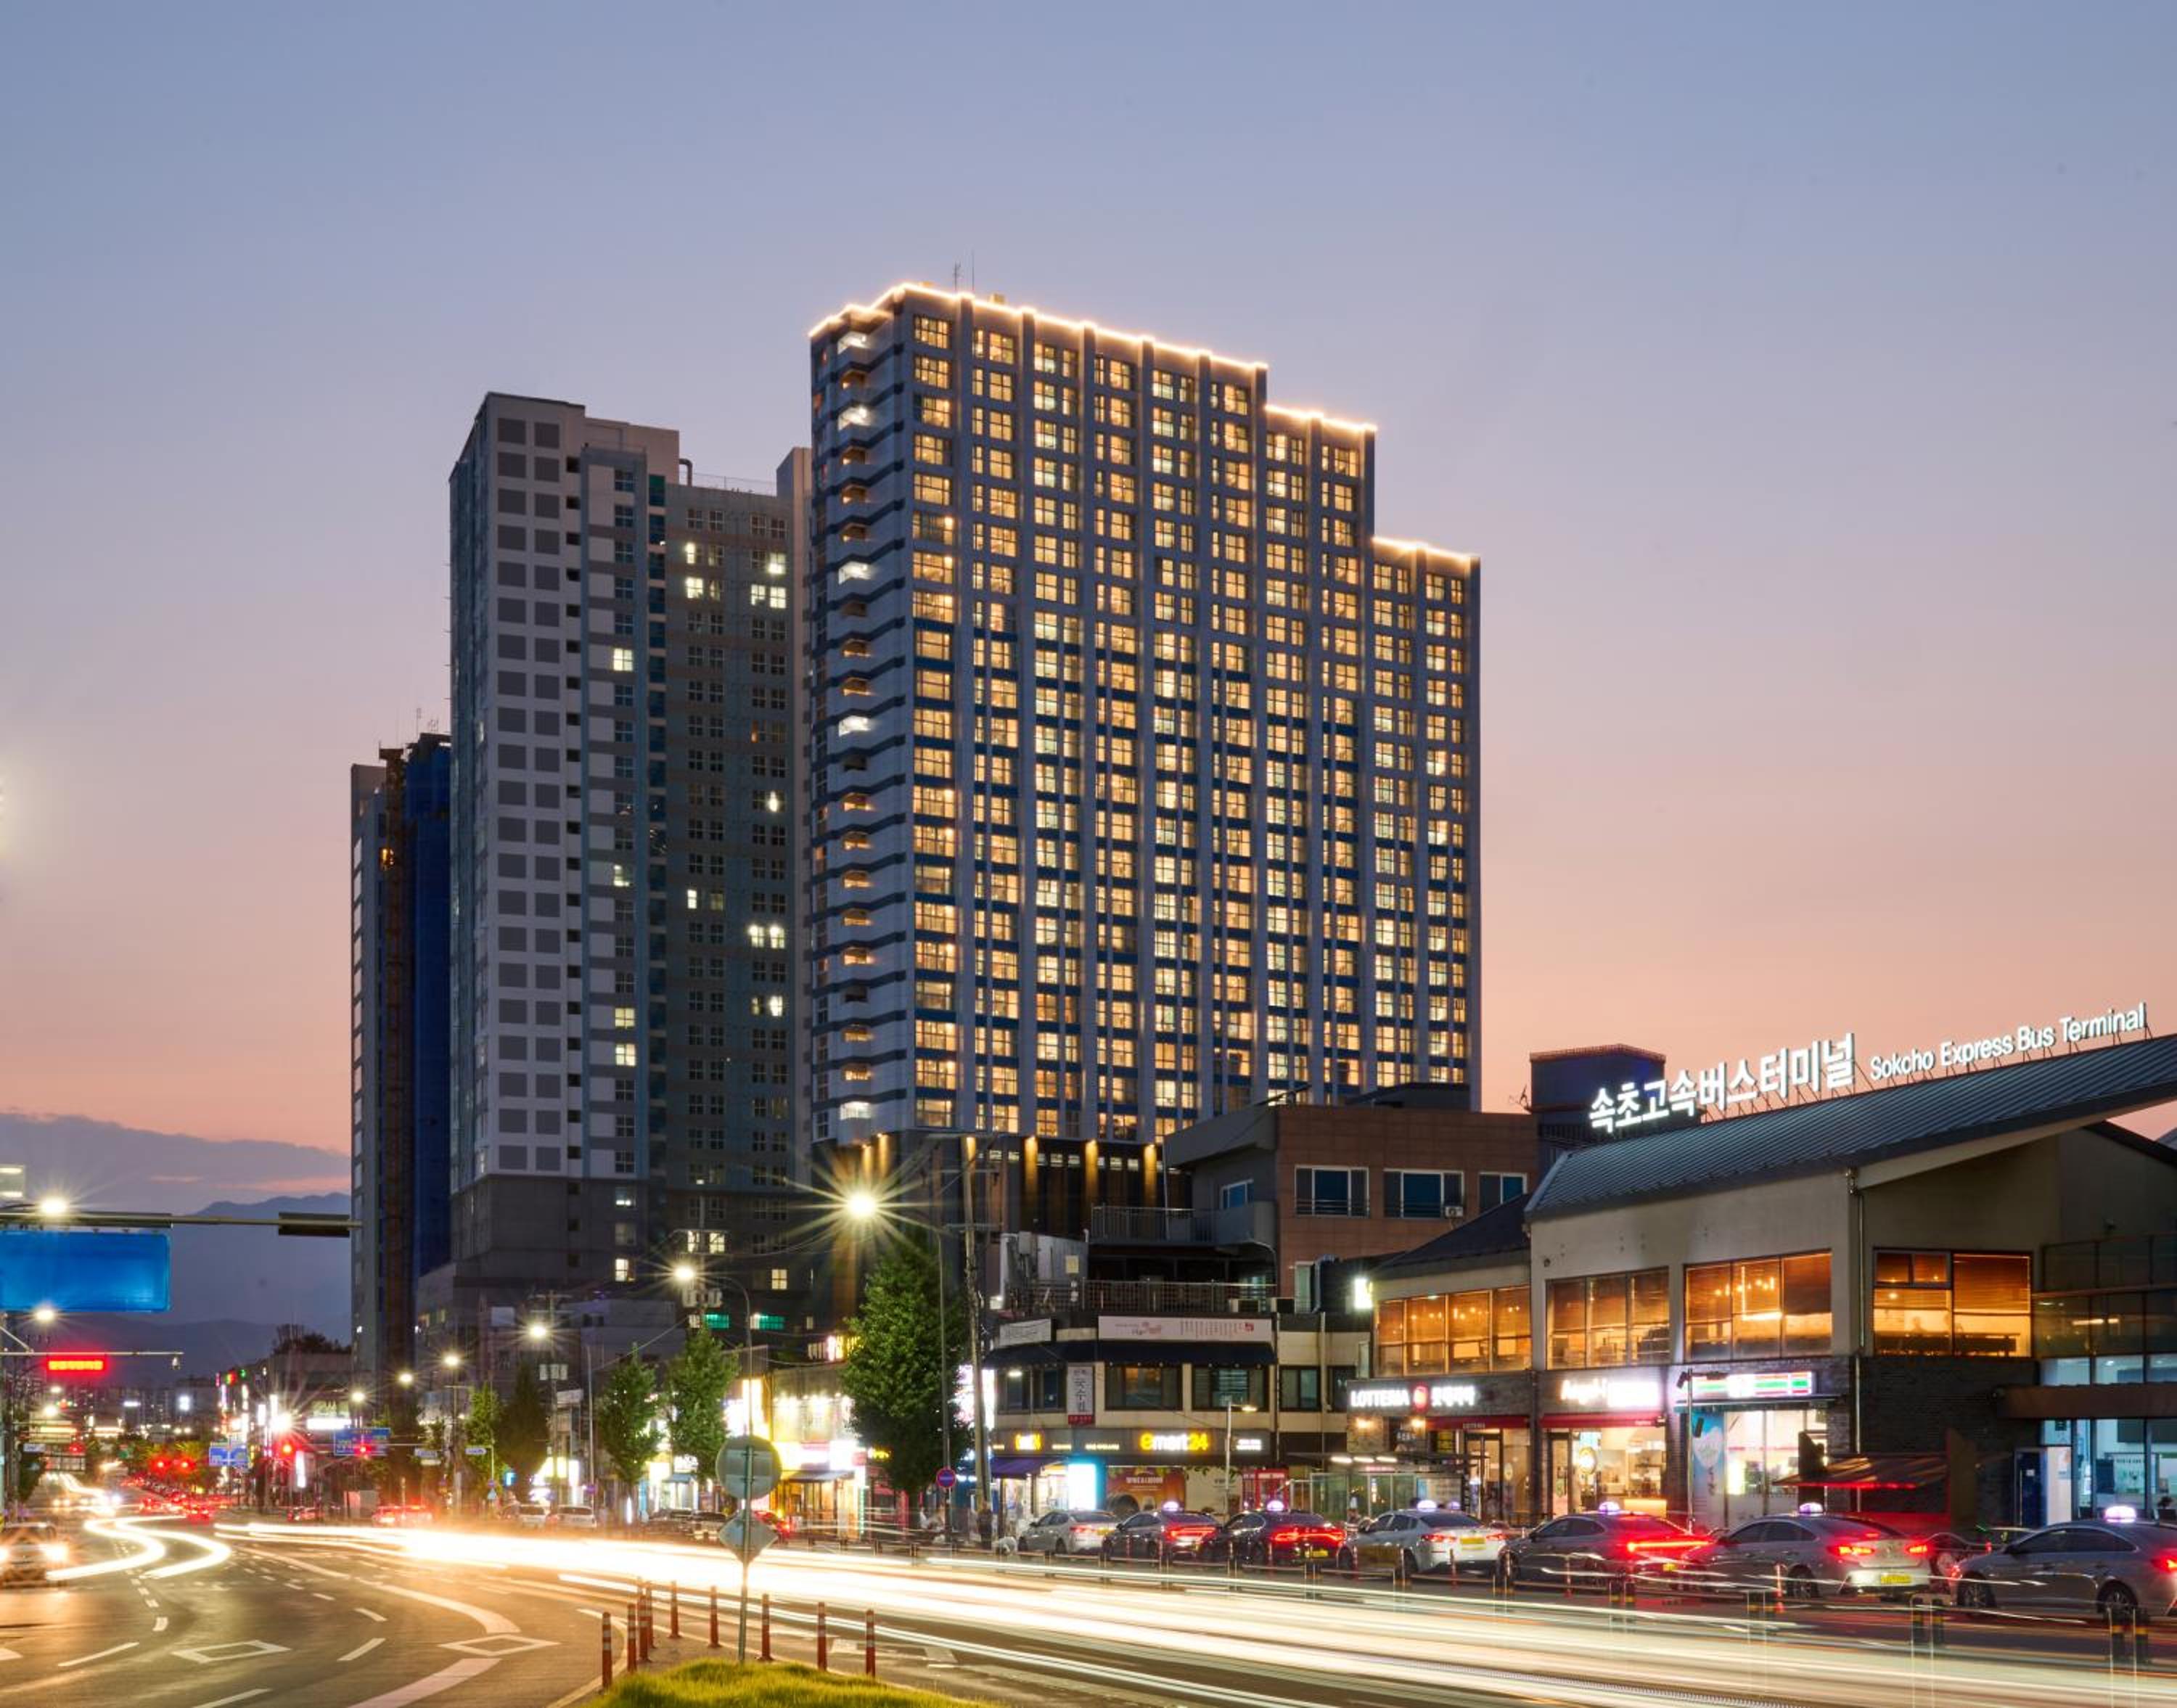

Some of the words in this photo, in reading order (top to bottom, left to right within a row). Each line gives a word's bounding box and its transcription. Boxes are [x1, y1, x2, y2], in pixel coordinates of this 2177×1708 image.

[1870, 1048, 1934, 1080] Sokcho
[1940, 1033, 2014, 1067] Express
[2017, 1025, 2055, 1052] Bus
[2059, 1002, 2146, 1043] Terminal
[1588, 1032, 1854, 1134] 속초고속버스터미널
[1351, 1389, 1410, 1407] LOTTERIA
[1140, 1433, 1208, 1450] emart24
